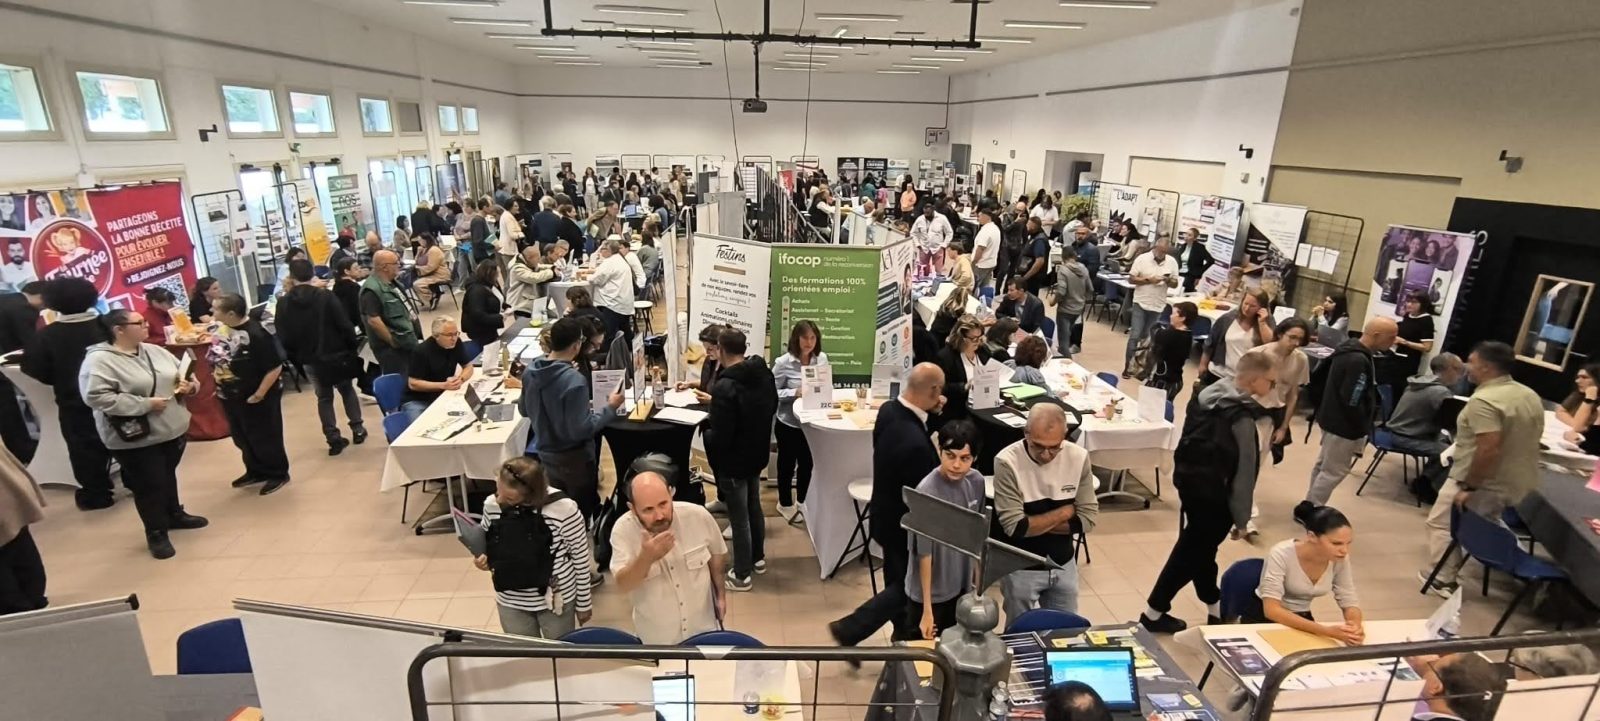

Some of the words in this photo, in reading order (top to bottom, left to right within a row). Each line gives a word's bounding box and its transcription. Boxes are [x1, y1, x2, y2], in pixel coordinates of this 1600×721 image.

[106, 211, 159, 232] PARTAGEONS
[111, 233, 124, 245] LA
[122, 225, 151, 241] BONNE
[150, 217, 183, 234] RECETTE
[115, 243, 137, 257] POUR
[716, 245, 746, 263] Festins
[120, 248, 161, 271] ENSEMBLE
[778, 252, 821, 268] ifocop
[782, 275, 798, 283] Des
[800, 276, 844, 284] formations
[846, 277, 866, 285] 100%
[782, 285, 820, 293] orientées
[822, 286, 851, 294] emploi
[715, 307, 738, 318] Cocktails
